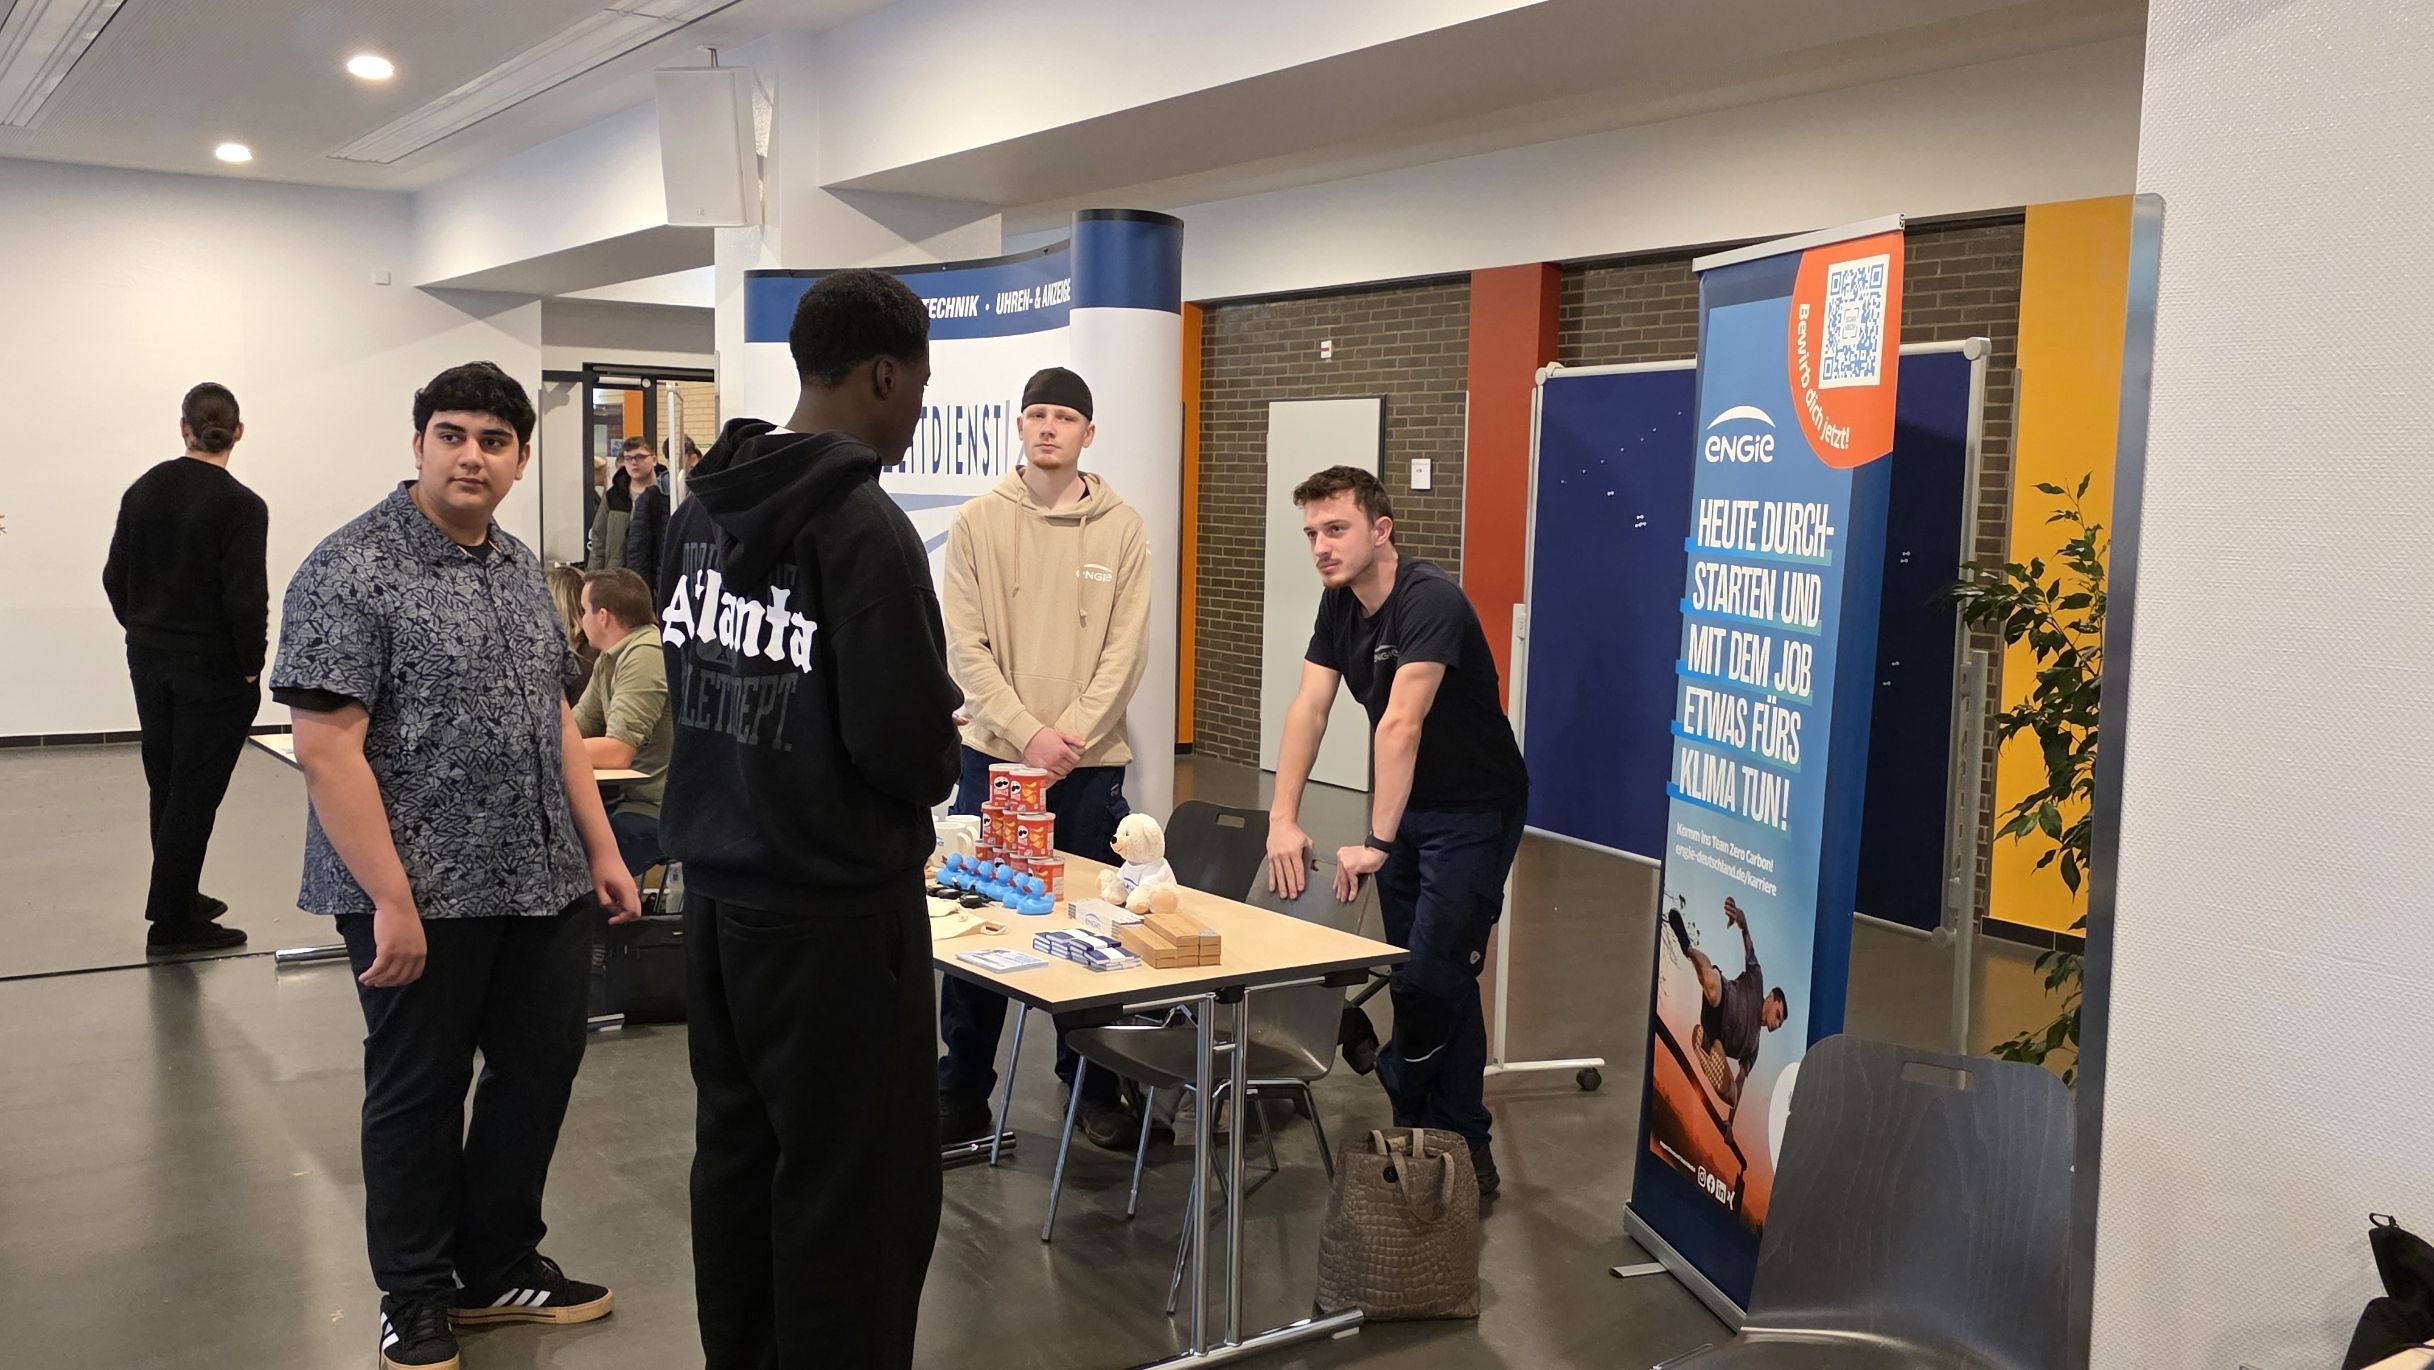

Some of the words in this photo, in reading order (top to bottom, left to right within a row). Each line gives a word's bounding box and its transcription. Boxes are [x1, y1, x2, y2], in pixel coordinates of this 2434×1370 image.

[996, 288, 1033, 315] UHREN-
[1034, 286, 1042, 310] &
[1797, 303, 1811, 389] Bewirb
[1805, 387, 1824, 431] dich
[1820, 415, 1850, 450] jetzt!
[882, 403, 1001, 477] TDIENST
[1697, 498, 1759, 551] HEUTE
[1760, 501, 1835, 558] DURCH-
[1692, 561, 1776, 621] STARTEN
[1781, 571, 1822, 628] UND
[1687, 623, 1727, 677] MIT
[1728, 630, 1771, 688] DEM
[1774, 639, 1813, 697] JOB
[1683, 685, 1748, 749] ETWAS
[1751, 694, 1801, 765] FÜRS
[1679, 747, 1736, 812] KLIMA
[1742, 765, 1790, 832] TUN!
[1675, 844, 1777, 896] engie-deutschland.de/karriere
[1676, 822, 1700, 842] Komm
[1700, 830, 1711, 847] ins
[1712, 835, 1730, 854] Team
[1729, 842, 1746, 861] Zero
[1745, 849, 1774, 873] Carbon!
